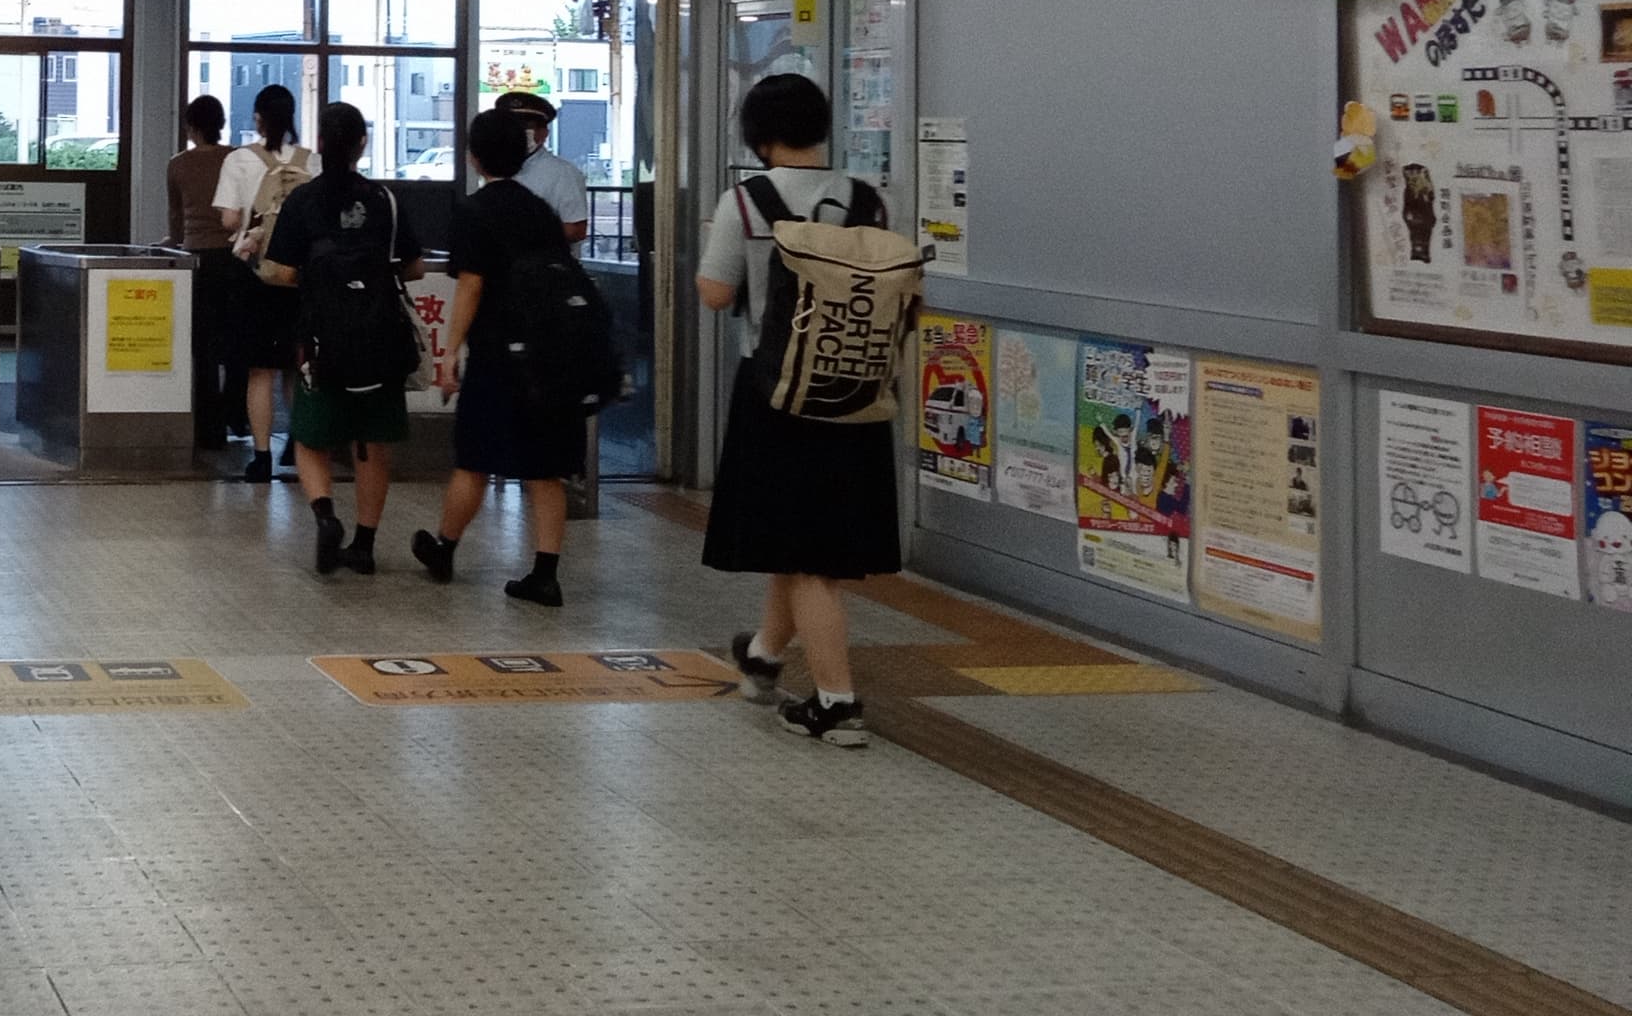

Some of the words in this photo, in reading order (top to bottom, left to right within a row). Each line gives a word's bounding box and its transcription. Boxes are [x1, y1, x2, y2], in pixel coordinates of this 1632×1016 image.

[124, 288, 158, 301] ご案内
[839, 274, 875, 378] NORTH
[814, 301, 847, 374] FACE
[867, 322, 893, 379] THE
